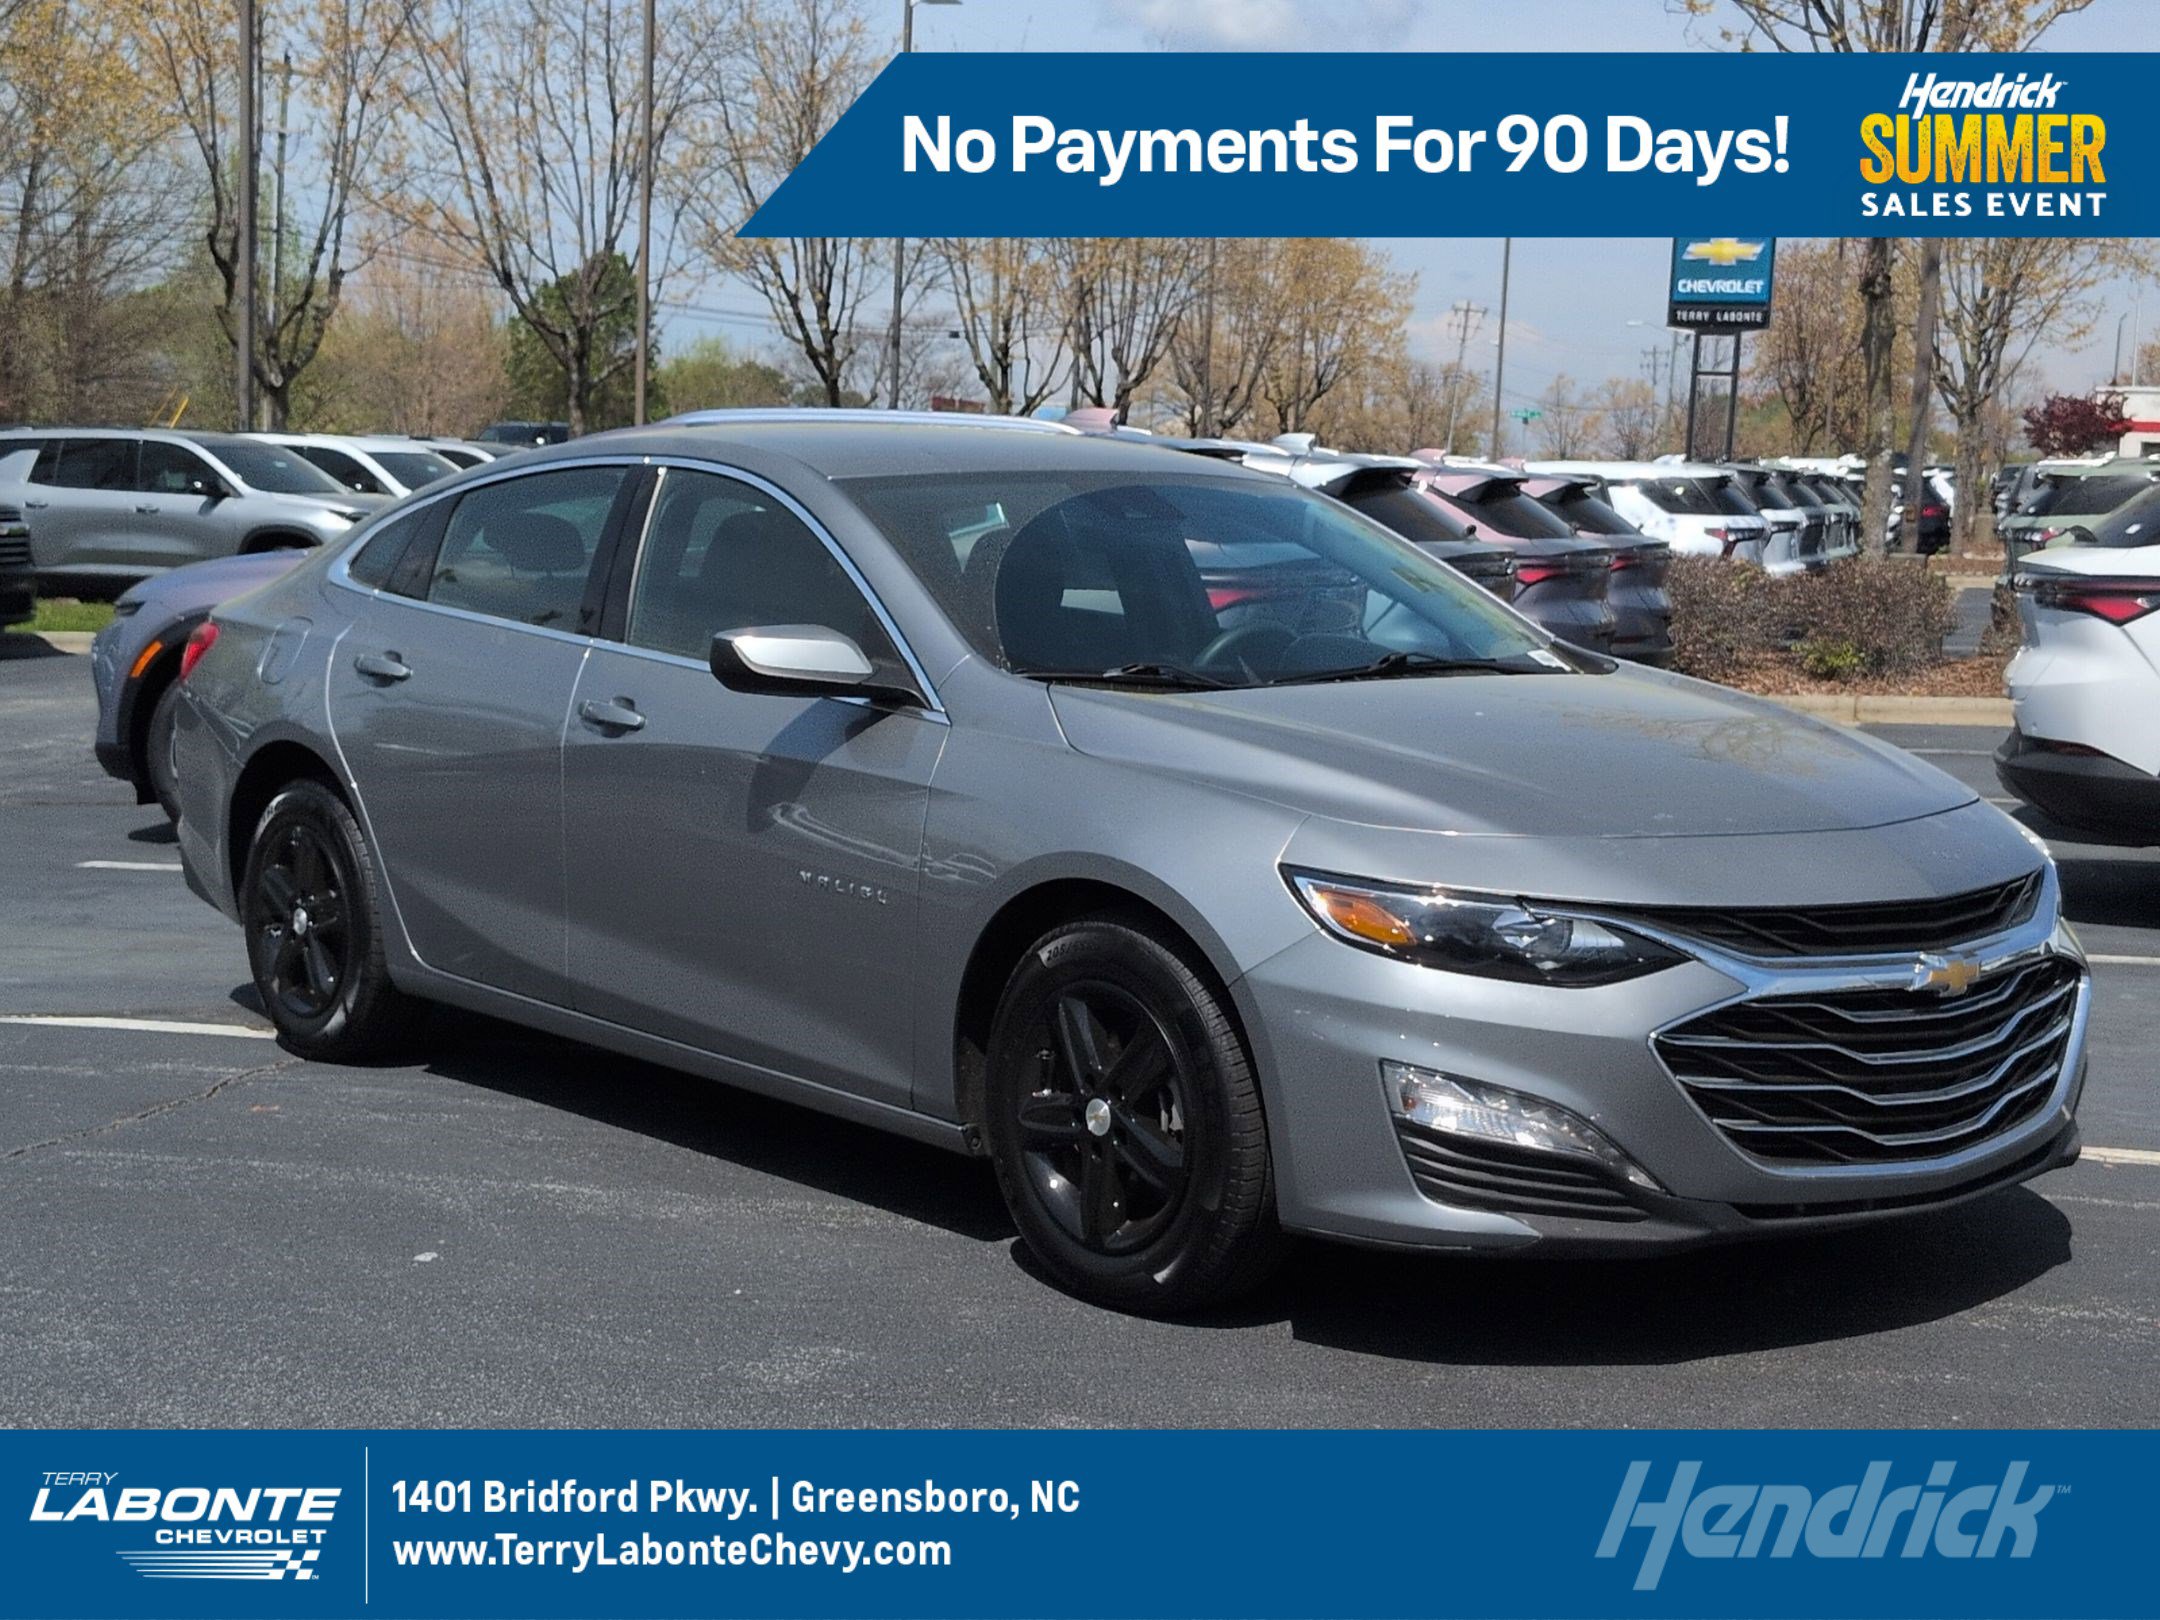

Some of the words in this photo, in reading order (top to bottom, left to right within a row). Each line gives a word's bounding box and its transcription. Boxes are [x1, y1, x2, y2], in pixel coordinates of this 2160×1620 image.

[1677, 279, 1764, 294] CHEVROLET
[1676, 310, 1710, 322] TERRY
[1716, 311, 1763, 323] LABONTE
